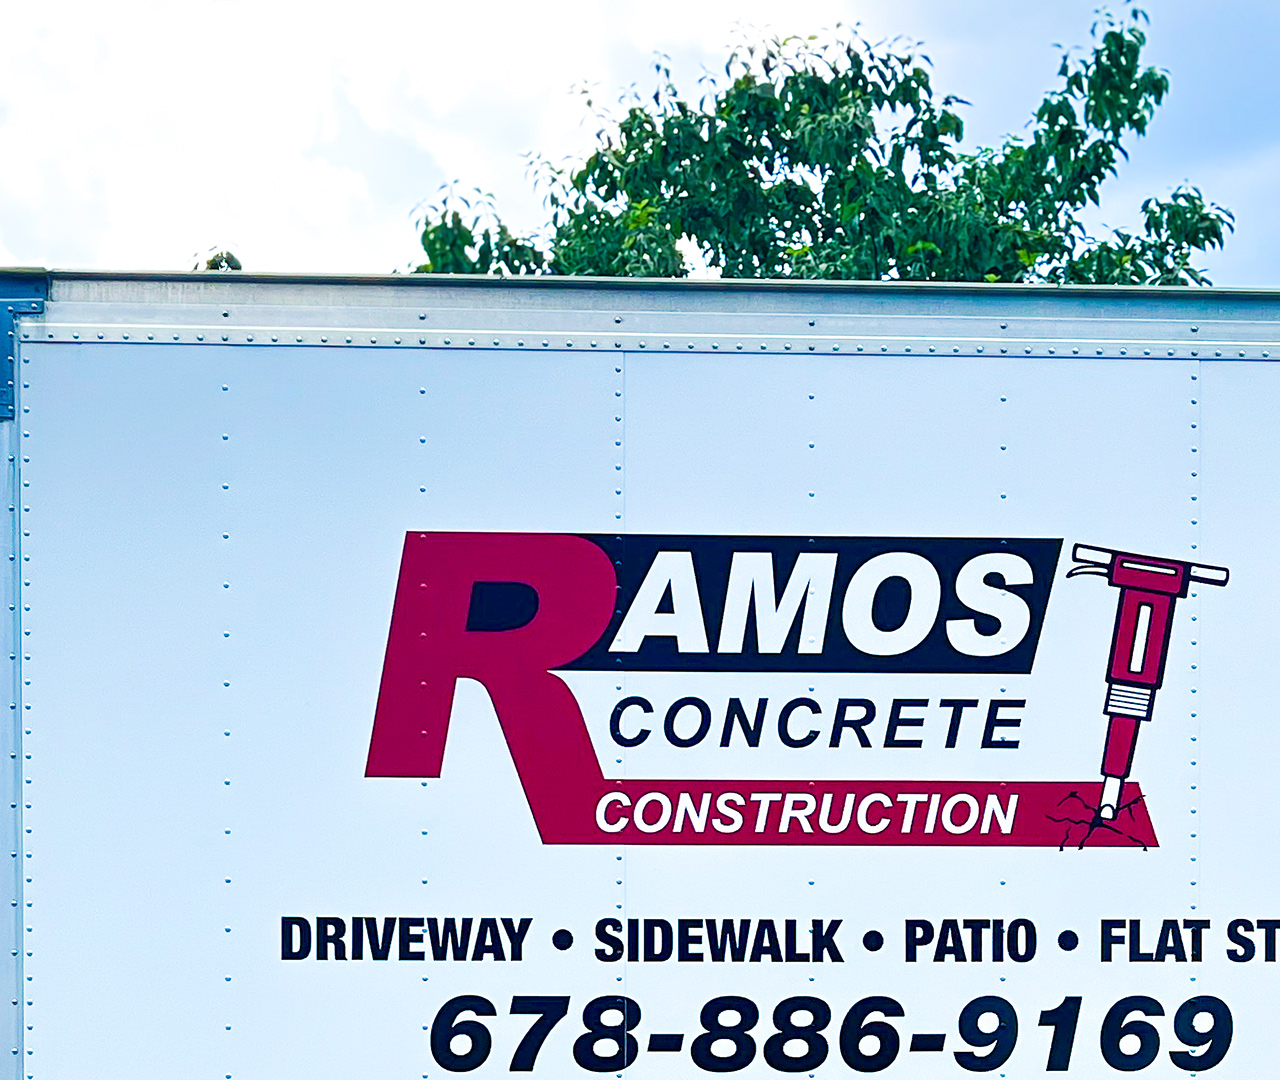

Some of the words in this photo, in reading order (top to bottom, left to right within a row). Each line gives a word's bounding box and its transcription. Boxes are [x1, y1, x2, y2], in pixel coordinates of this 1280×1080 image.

[365, 531, 1033, 780] RAMOS
[609, 696, 1027, 749] CONCRETE
[595, 791, 1019, 835] CONSTRUCTION
[281, 916, 533, 962] DRIVEWAY
[594, 917, 845, 963] SIDEWALK
[904, 918, 1037, 963] PATIO
[1100, 918, 1211, 963] FLAT
[430, 994, 1234, 1073] 678-886-9169
